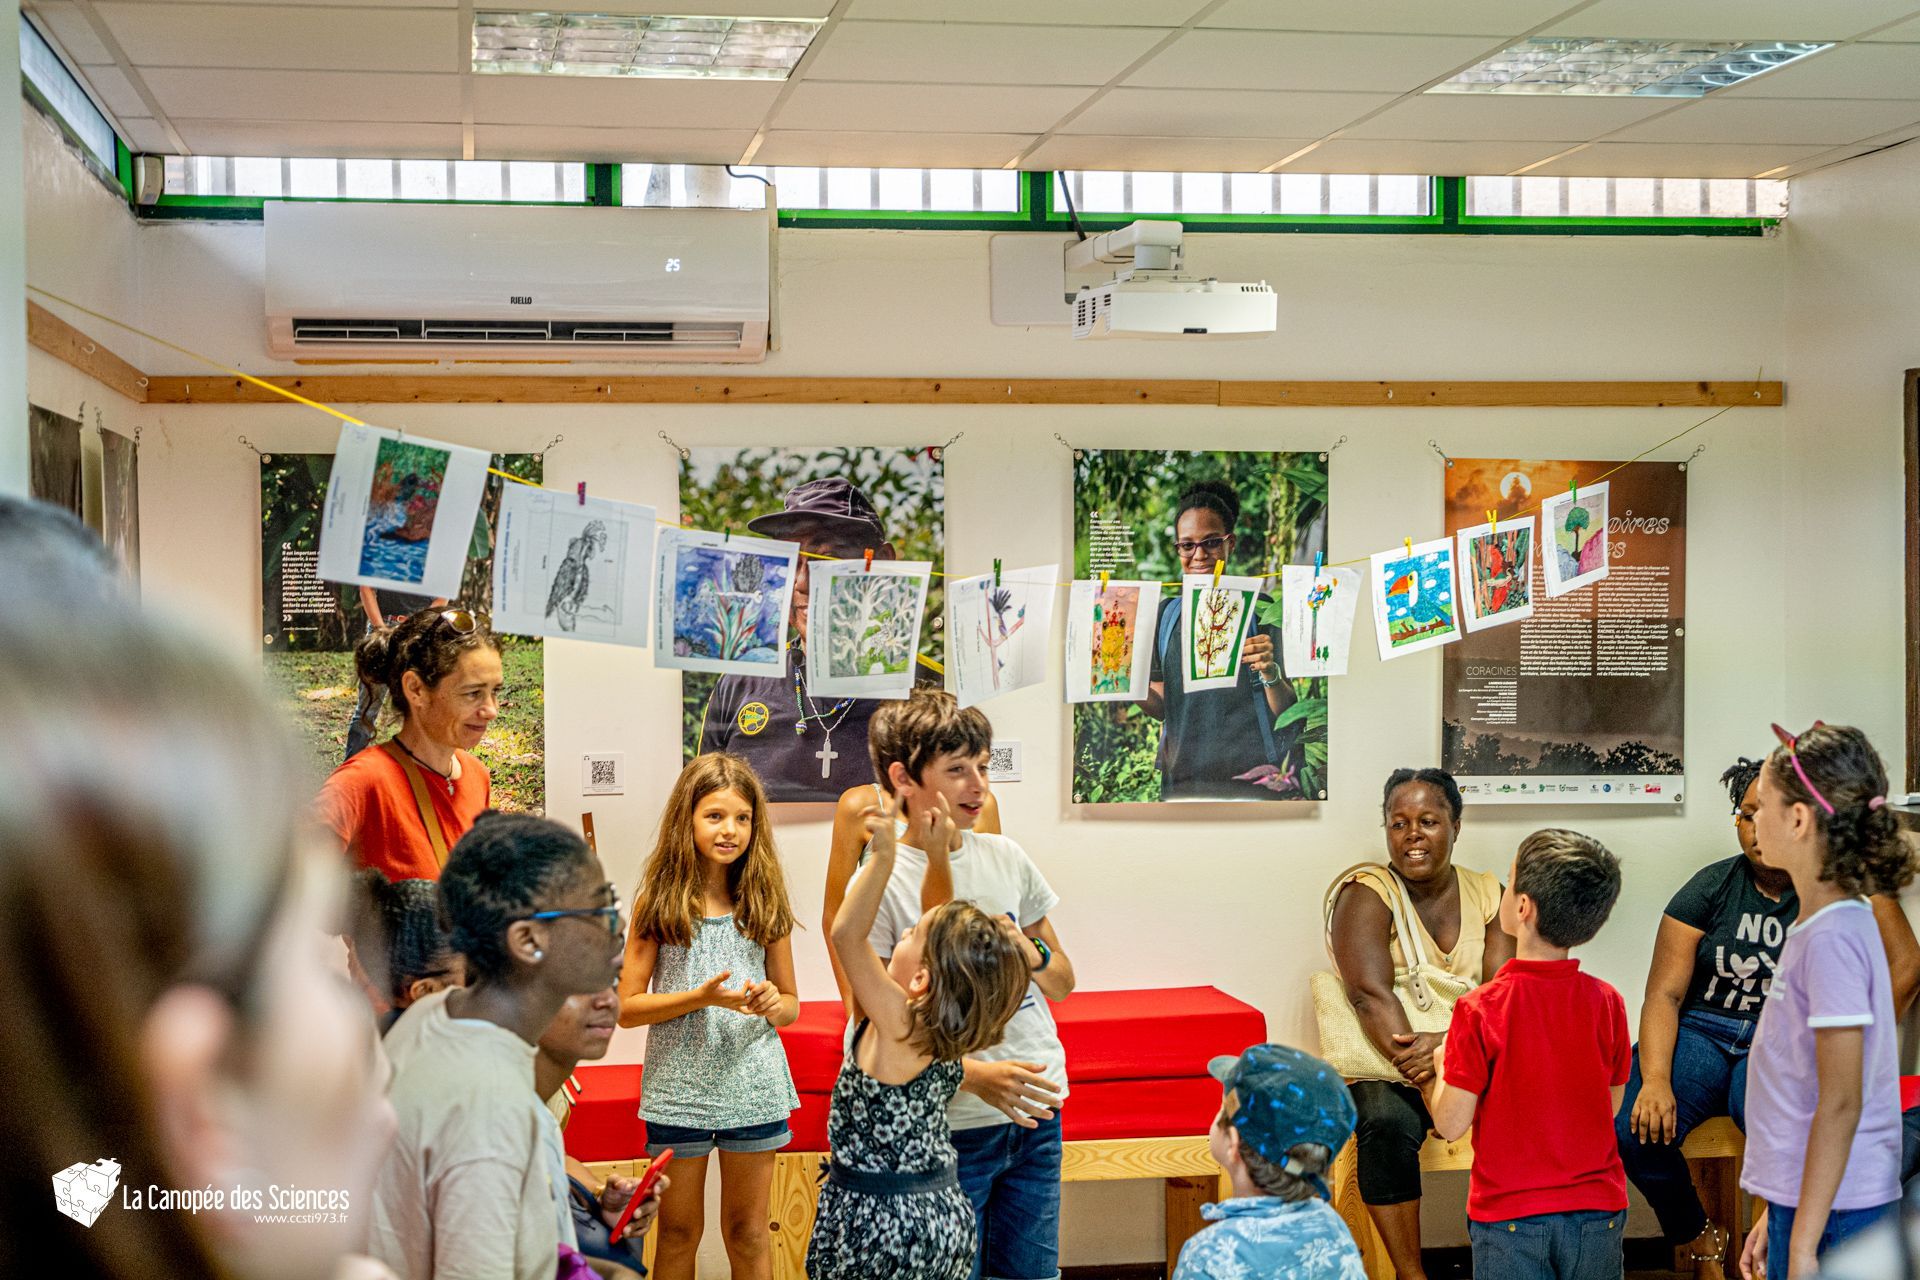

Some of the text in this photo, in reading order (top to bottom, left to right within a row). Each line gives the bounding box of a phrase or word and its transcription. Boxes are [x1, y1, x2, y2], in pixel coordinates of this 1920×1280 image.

[665, 258, 680, 272] 25
[510, 296, 532, 305] RIELLO
[1466, 666, 1517, 676] CORACINES
[1736, 913, 1783, 948] NO
